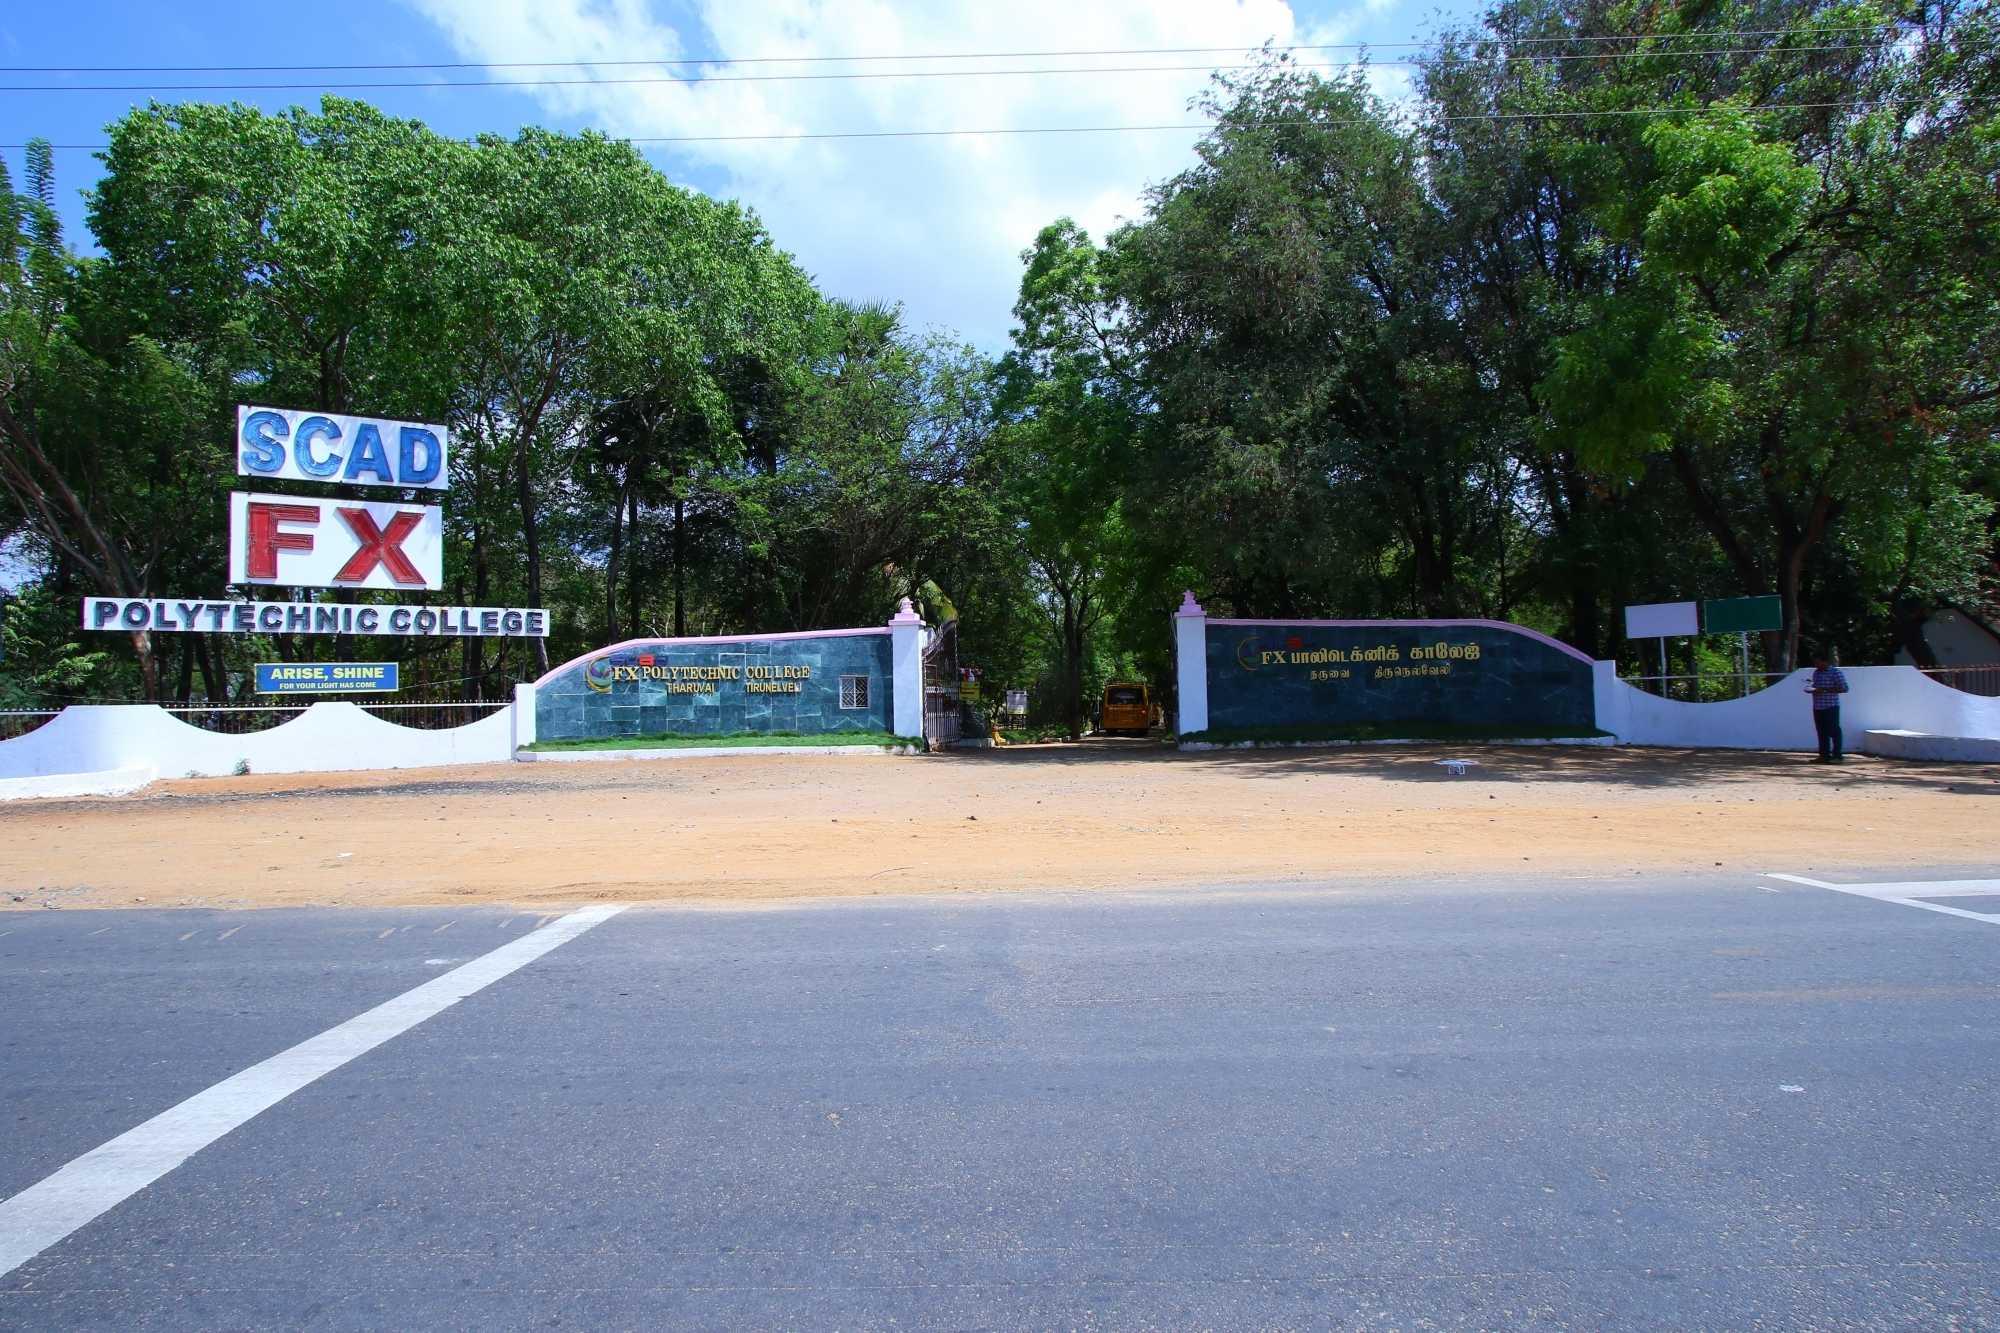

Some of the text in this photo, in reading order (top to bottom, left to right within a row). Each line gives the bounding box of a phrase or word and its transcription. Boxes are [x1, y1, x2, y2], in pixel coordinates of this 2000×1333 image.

[242, 411, 442, 485] SCAD
[246, 502, 426, 585] FX
[94, 601, 544, 635] POLYTECHNIC COLLEGE
[1261, 651, 1287, 665] FX
[271, 667, 385, 681] ARISE, SHINE
[613, 665, 810, 680] FX POLYTECHNIC COLLEGE
[295, 682, 316, 690] YOUR
[666, 682, 802, 693] THARUVAI TIRUNELVELI
